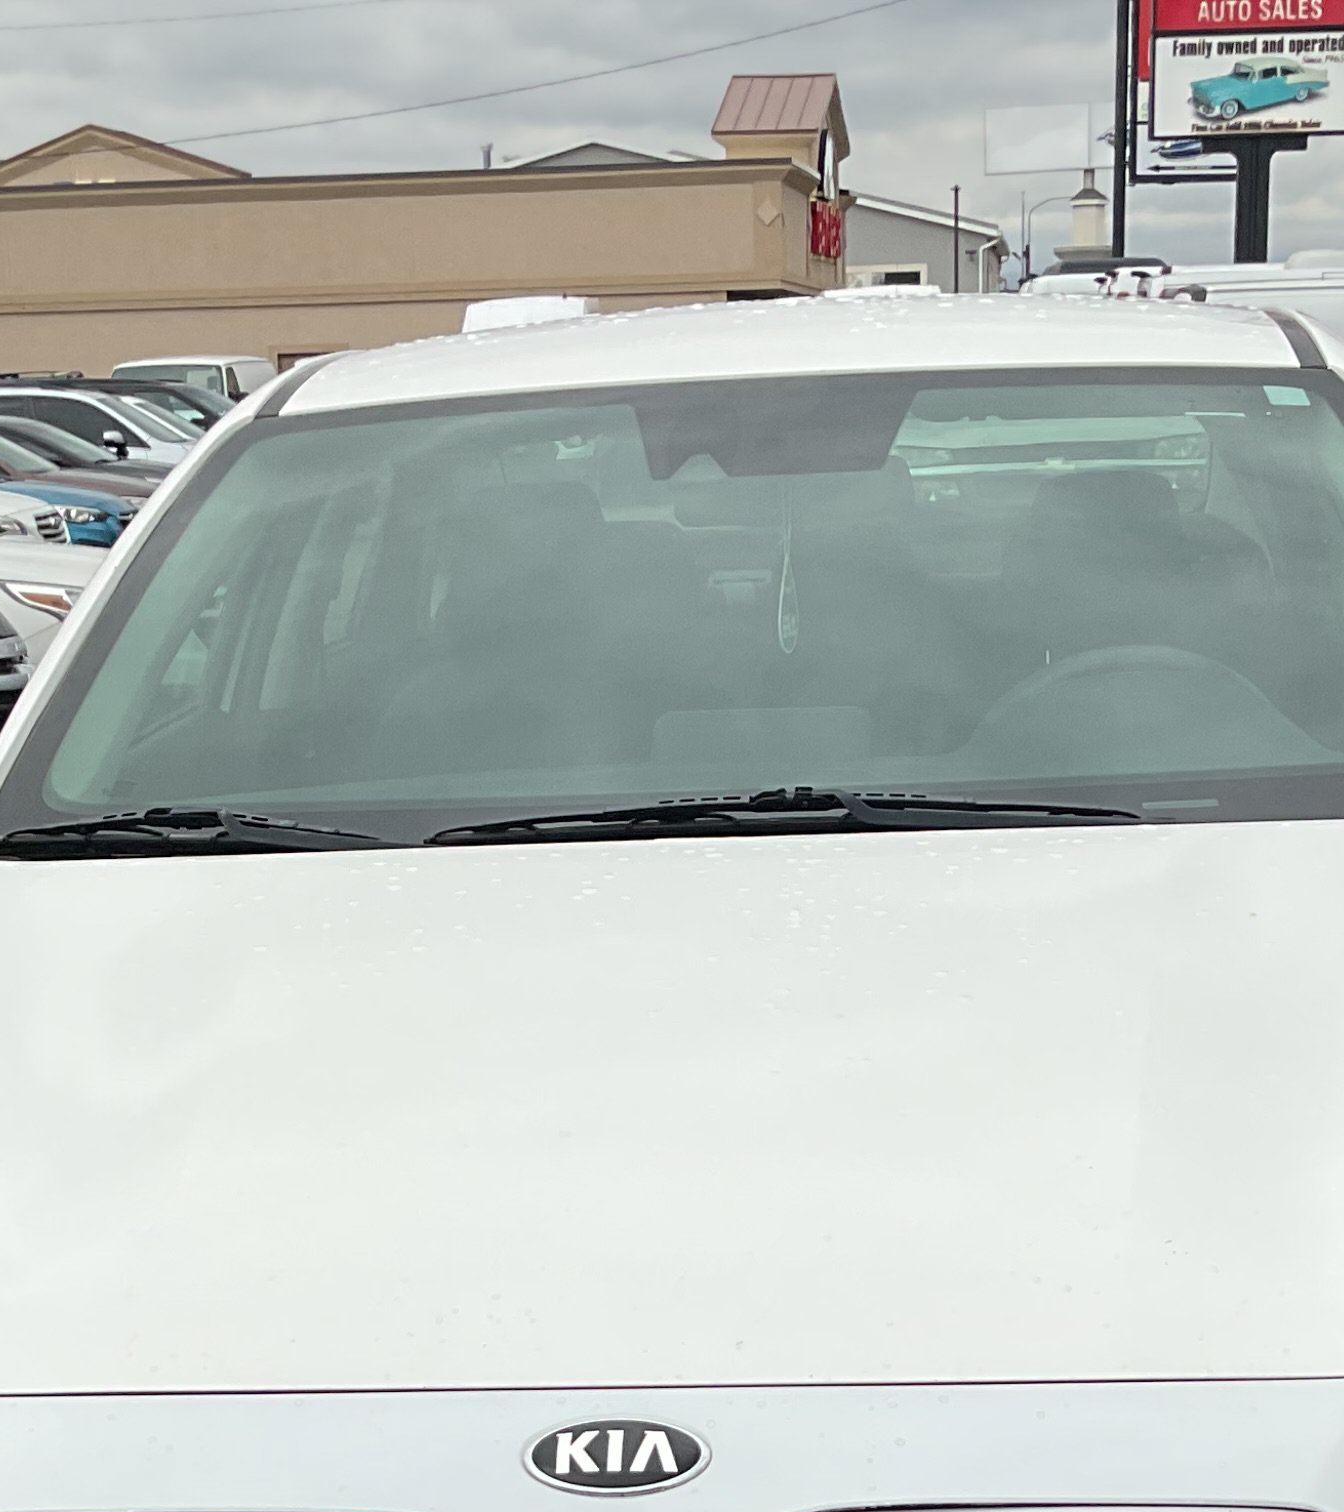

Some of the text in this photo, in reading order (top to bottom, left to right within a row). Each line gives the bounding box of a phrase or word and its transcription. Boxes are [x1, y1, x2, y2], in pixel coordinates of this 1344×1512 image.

[1197, 0, 1324, 22] AUTO SALES
[1172, 36, 1213, 59] Family
[1216, 36, 1257, 56] owned
[1262, 36, 1285, 54] and
[555, 1429, 679, 1474] KIA
